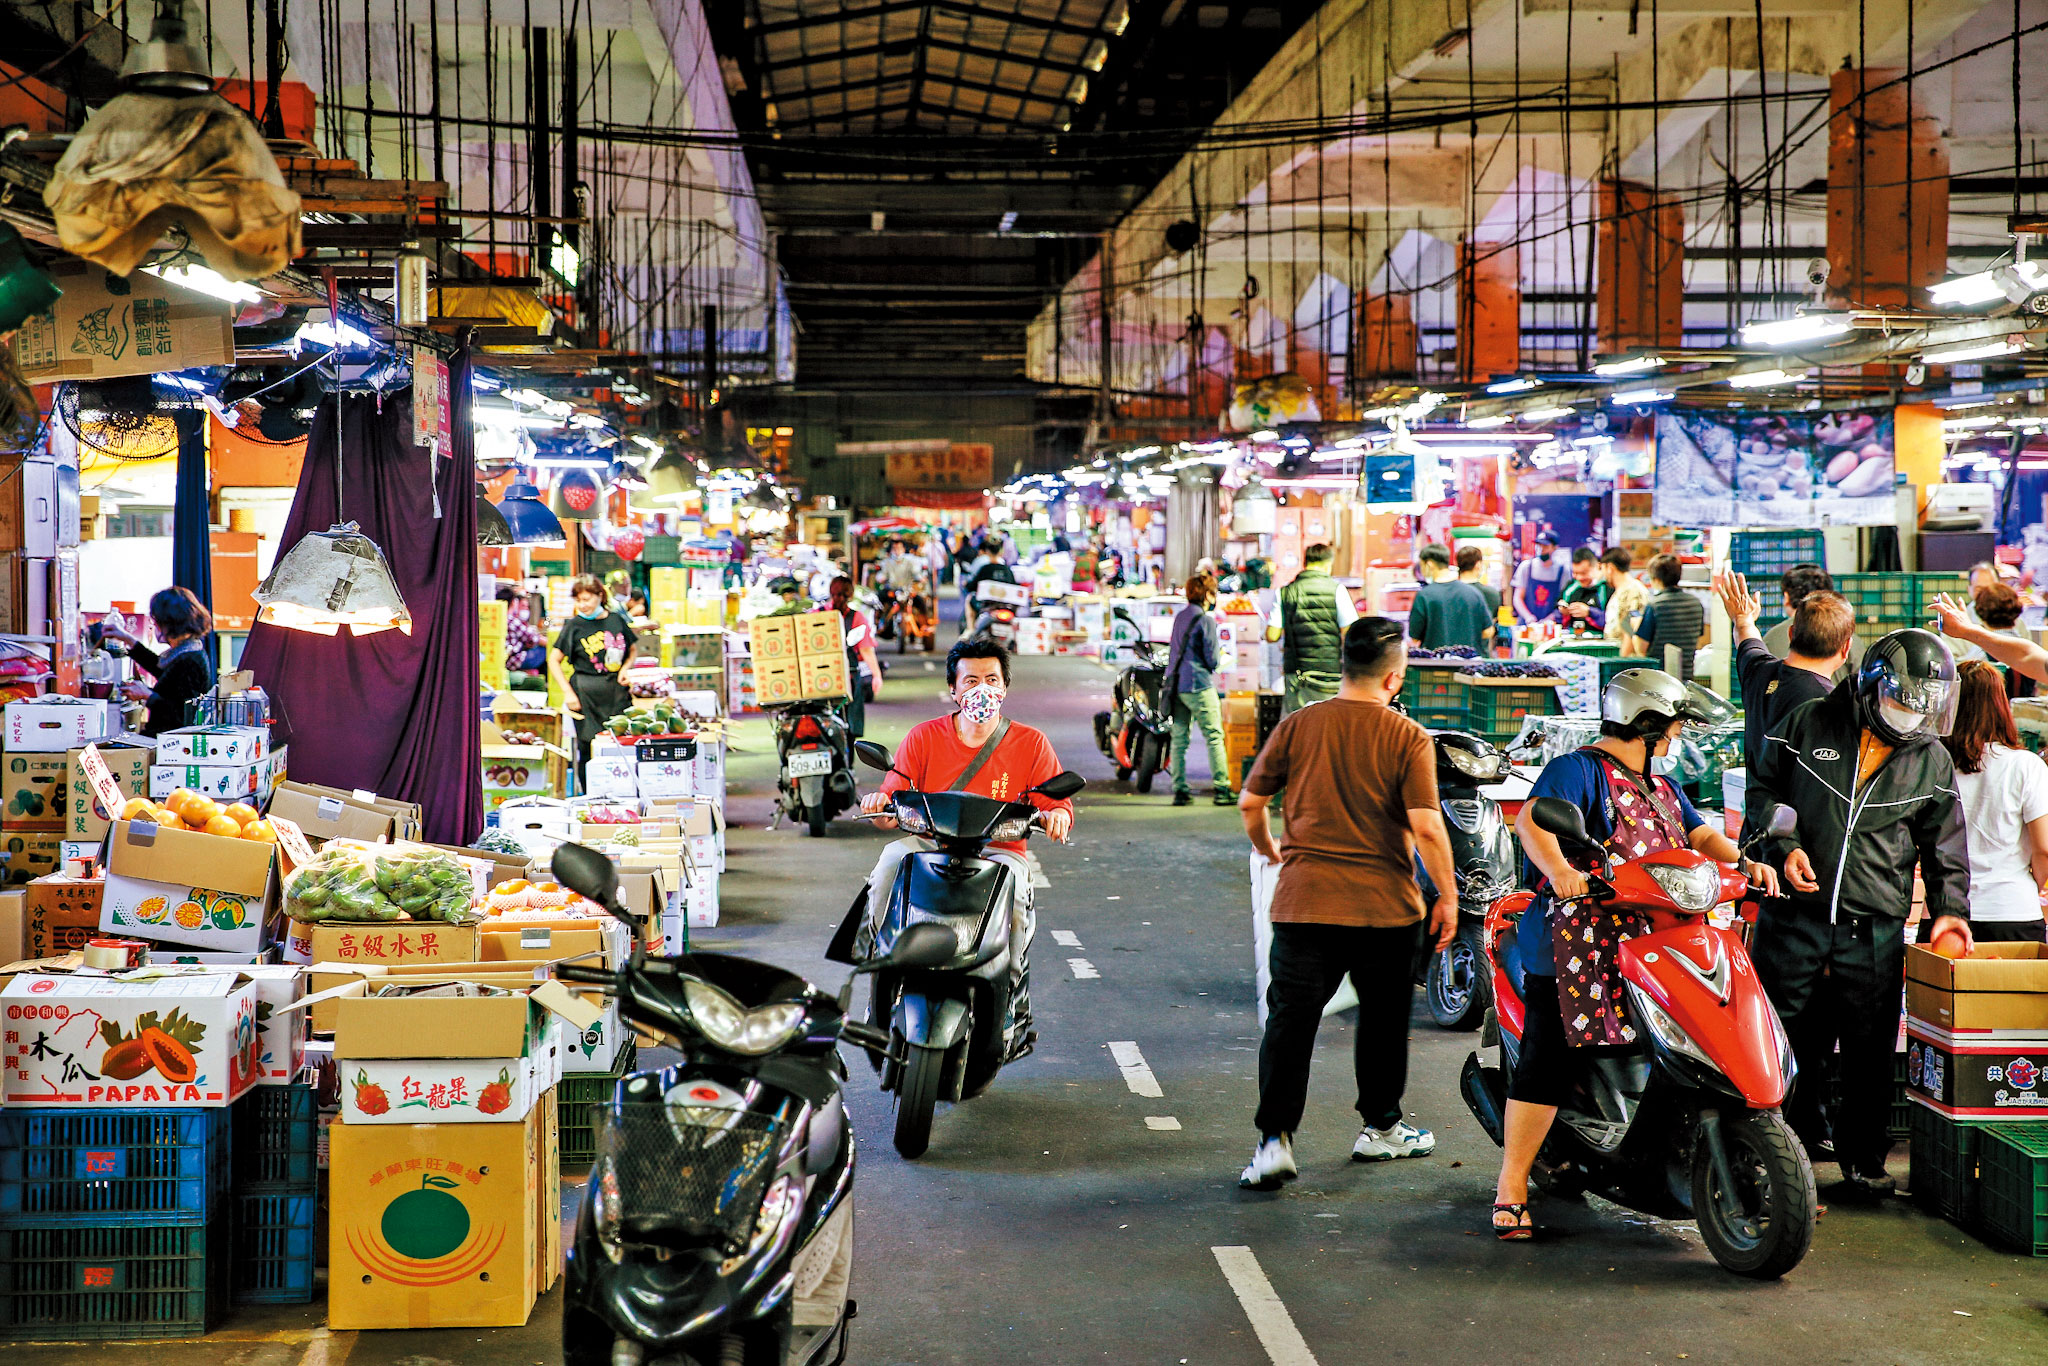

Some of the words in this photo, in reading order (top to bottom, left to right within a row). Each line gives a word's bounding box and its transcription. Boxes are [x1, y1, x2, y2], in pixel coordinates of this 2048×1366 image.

[12, 714, 23, 744] 分級包裝
[73, 763, 90, 833] 分級包裝
[337, 933, 440, 959] 高級水果
[8, 1005, 69, 1019] 南化和興
[29, 1030, 101, 1084] 木瓜
[88, 1085, 202, 1102] PAPAYA
[402, 1076, 469, 1109] 紅龍果
